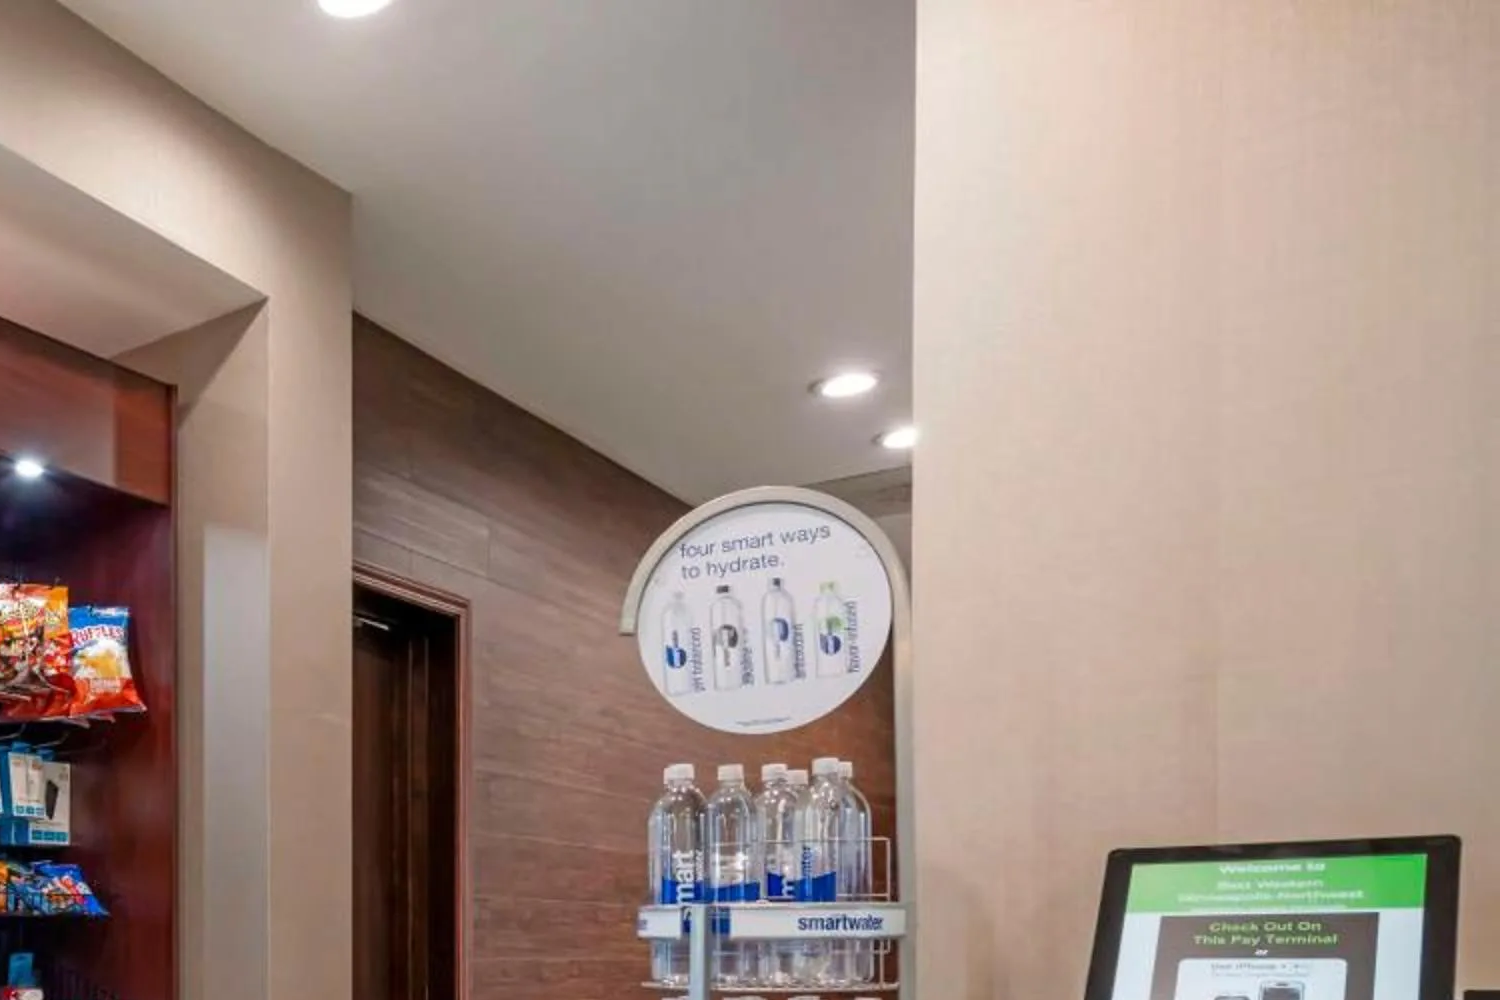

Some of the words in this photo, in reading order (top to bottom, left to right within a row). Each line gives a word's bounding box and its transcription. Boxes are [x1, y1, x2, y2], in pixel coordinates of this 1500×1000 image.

[679, 541, 714, 559] four
[721, 531, 775, 554] smart
[780, 523, 832, 546] ways
[681, 564, 700, 581] to
[706, 553, 785, 579] hydrate.
[1219, 862, 1302, 875] Welcome
[1306, 861, 1326, 872] to
[797, 913, 885, 932] smartwater
[1208, 921, 1258, 934] Check
[1263, 920, 1294, 932] Out
[1297, 920, 1322, 932] On
[1193, 935, 1226, 946] This
[1230, 935, 1261, 948] Pay
[1265, 933, 1339, 946] Terminal
